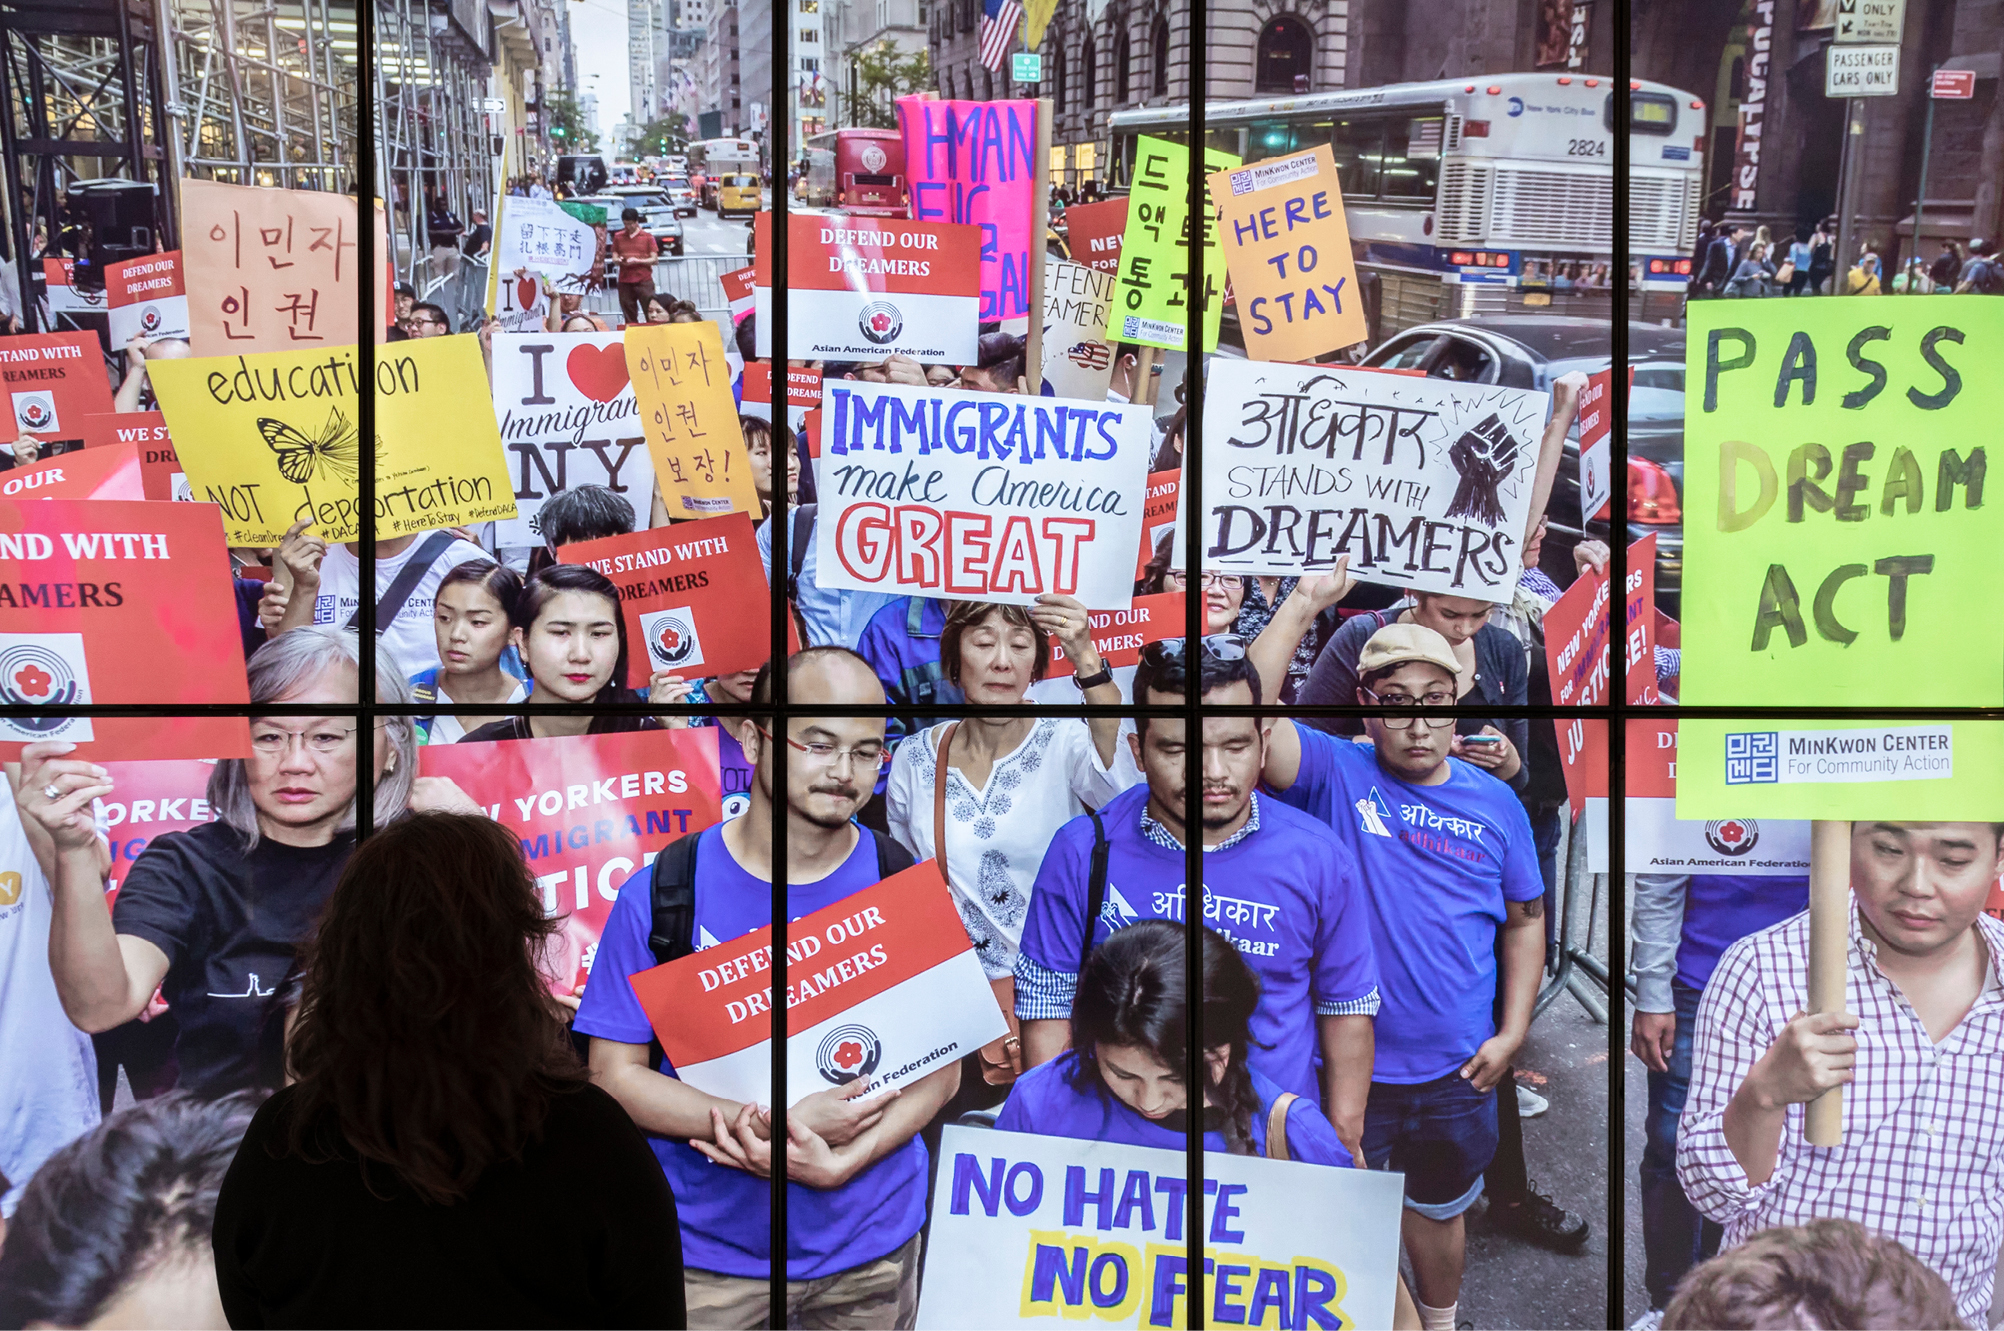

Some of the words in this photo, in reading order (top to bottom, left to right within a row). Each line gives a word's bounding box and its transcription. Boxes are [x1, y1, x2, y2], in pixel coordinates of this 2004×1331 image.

[1863, 3, 1896, 15] ONLY
[1833, 53, 1894, 68] PASSENGER
[1833, 72, 1860, 86] CARS
[1866, 71, 1893, 85] ONLY
[1563, 106, 1579, 116] City
[1290, 156, 1316, 170] CENTER
[1568, 139, 1605, 157] 2824
[1267, 171, 1299, 185] Community
[1300, 165, 1318, 175] Action
[1234, 190, 1332, 247] HERE
[209, 210, 357, 283] 이민자
[820, 228, 895, 247] DEFEND
[900, 232, 939, 250] OUR
[122, 264, 154, 280] DEFEND
[155, 260, 175, 272] OUR
[738, 269, 756, 281] DEFE
[1091, 258, 1118, 270] FOR
[1268, 245, 1318, 279] TO
[127, 277, 172, 295] DREAMERS
[502, 279, 514, 312] I
[1122, 257, 1218, 312] 통과
[221, 286, 323, 341] 인권
[1043, 295, 1108, 329] EAMER
[1250, 277, 1346, 335] STAY
[41, 346, 82, 360] WITH
[640, 340, 712, 391] 이민자
[812, 344, 841, 353] Asian
[843, 345, 892, 355] American
[894, 347, 945, 357] Federation
[3, 367, 66, 383] REAMERS
[208, 352, 419, 405] education
[519, 344, 555, 406] I
[767, 371, 819, 385] DEFEND
[1703, 325, 1966, 413] PASS
[770, 386, 822, 399] DREAME
[117, 427, 149, 442] WE
[501, 395, 641, 444] Immigran
[654, 400, 707, 443] 인권
[831, 387, 1122, 465] IMMIGRANTS
[1580, 411, 1600, 436] REAMERS
[3, 468, 66, 495] OUR
[508, 436, 647, 500] NY
[295, 476, 493, 527] deportation
[833, 459, 948, 502] make
[971, 466, 1128, 516] America
[1146, 483, 1176, 500] TAND
[1227, 464, 1353, 500] STANDS
[1365, 473, 1430, 511] WITH
[1716, 440, 1988, 533] DREAM
[205, 484, 265, 524] NOT
[1144, 500, 1177, 519] REAM
[392, 512, 461, 532] #HereToStay
[0, 533, 53, 560] ND
[60, 533, 171, 560] WITH
[585, 558, 613, 575] WE
[615, 547, 672, 573] STAND
[674, 536, 729, 561] WITH
[836, 502, 1095, 597] GREAT
[1207, 505, 1516, 590] DREAMERS
[0, 582, 124, 609] AMERS
[408, 597, 434, 607] CENT
[618, 571, 709, 602] DREAMERS
[1751, 554, 1936, 652] ACT
[419, 607, 434, 617] Act
[1115, 607, 1151, 626] OUR
[1556, 629, 1581, 676] NEW
[1582, 569, 1642, 638] YORKERS
[1560, 680, 1574, 705] FOR
[49, 689, 84, 737] Federaion
[1883, 734, 1949, 752] CENTER
[720, 766, 749, 792] OT
[1788, 758, 1812, 775] For
[1816, 755, 1898, 775] Community
[1903, 754, 1950, 771] Action
[105, 797, 223, 827] ORKE
[514, 769, 688, 822] YORKERS
[520, 809, 692, 861] MIGRANT
[1399, 829, 1486, 863] adhikaar
[1650, 858, 1684, 866] Asian
[1687, 858, 1746, 867] American
[1749, 859, 1811, 868] Federatio
[1151, 883, 1280, 932] अधिकार
[698, 936, 821, 992] DEFEND
[826, 906, 886, 945] OUR
[725, 943, 888, 1024] DREAMERS
[882, 1041, 958, 1085] Federation
[950, 1152, 1043, 1217] NO
[1064, 1164, 1247, 1244] HATE
[1031, 1244, 1128, 1308] NO
[1150, 1253, 1343, 1331] FEAR
